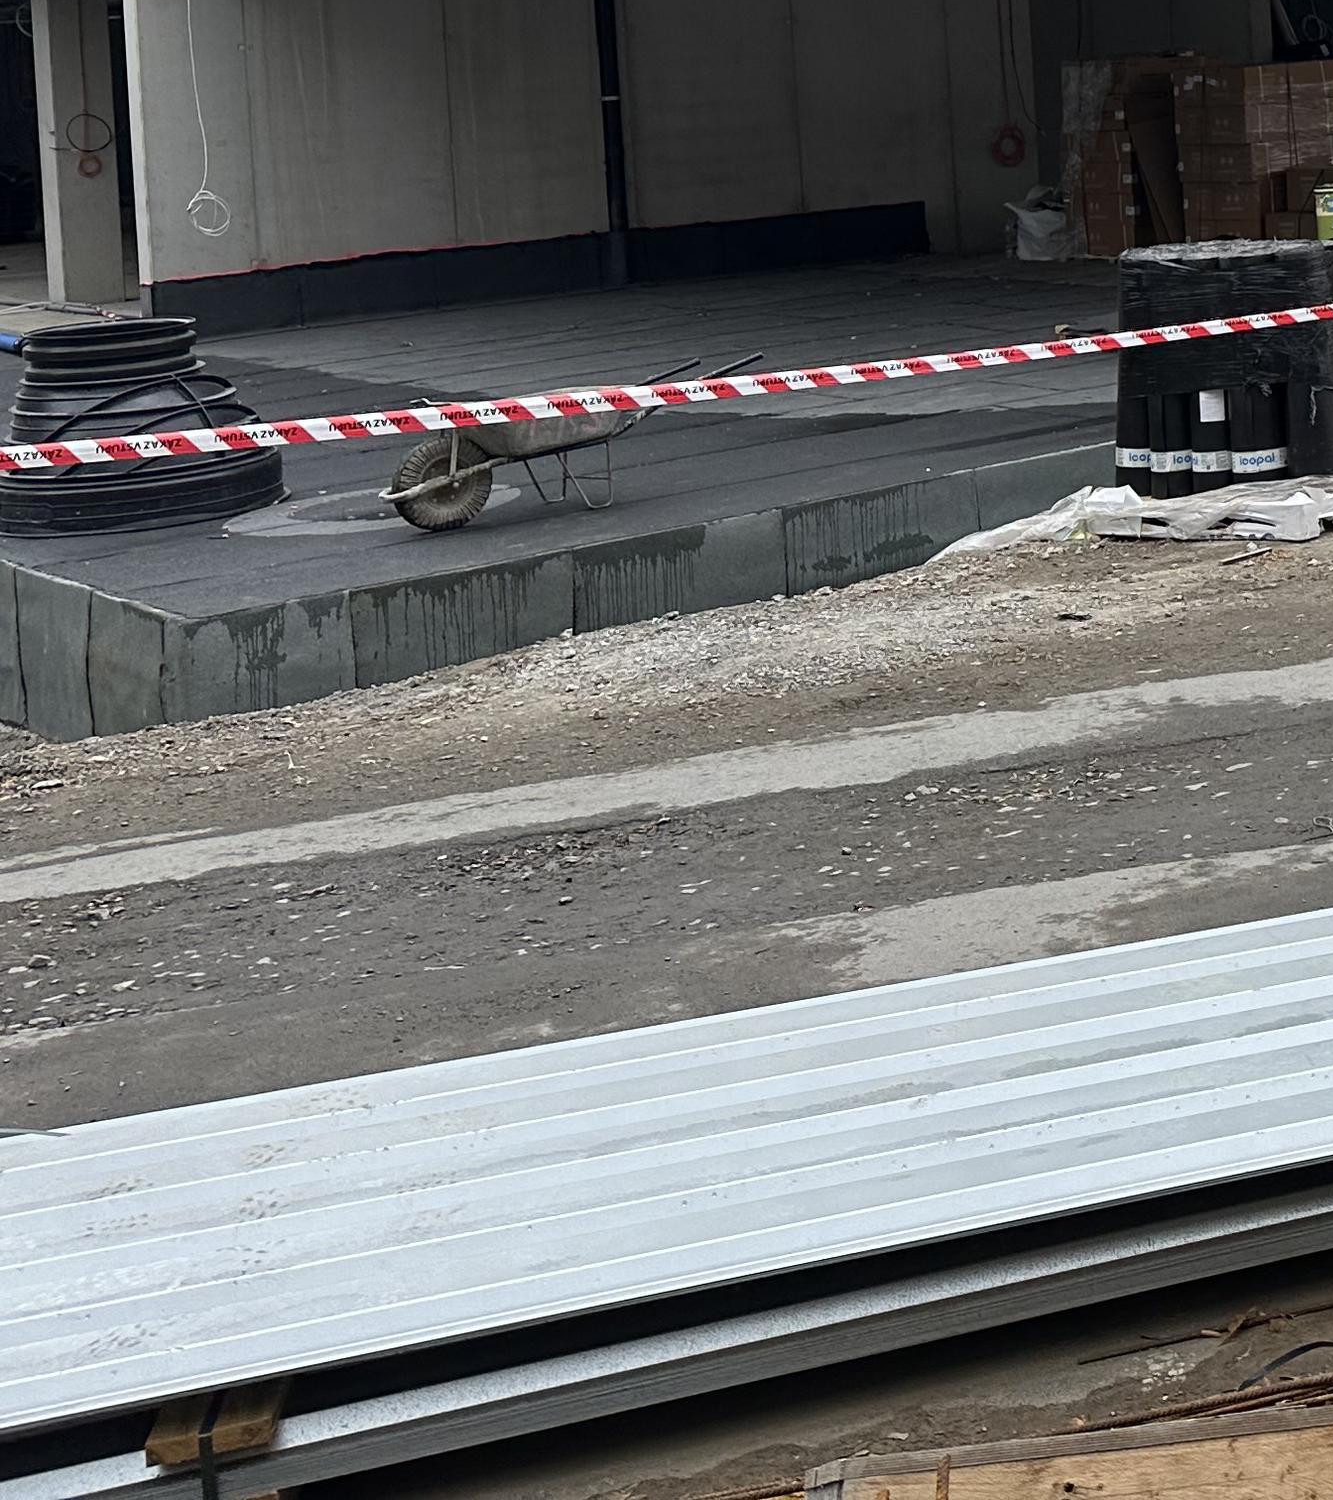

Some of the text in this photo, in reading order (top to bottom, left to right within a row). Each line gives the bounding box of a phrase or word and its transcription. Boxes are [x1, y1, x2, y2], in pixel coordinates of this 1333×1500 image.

[440, 409, 482, 421] VSTUPU
[329, 420, 372, 432] VSTUPU
[215, 431, 258, 443] VSTUPU
[95, 443, 140, 454] VSTUPU
